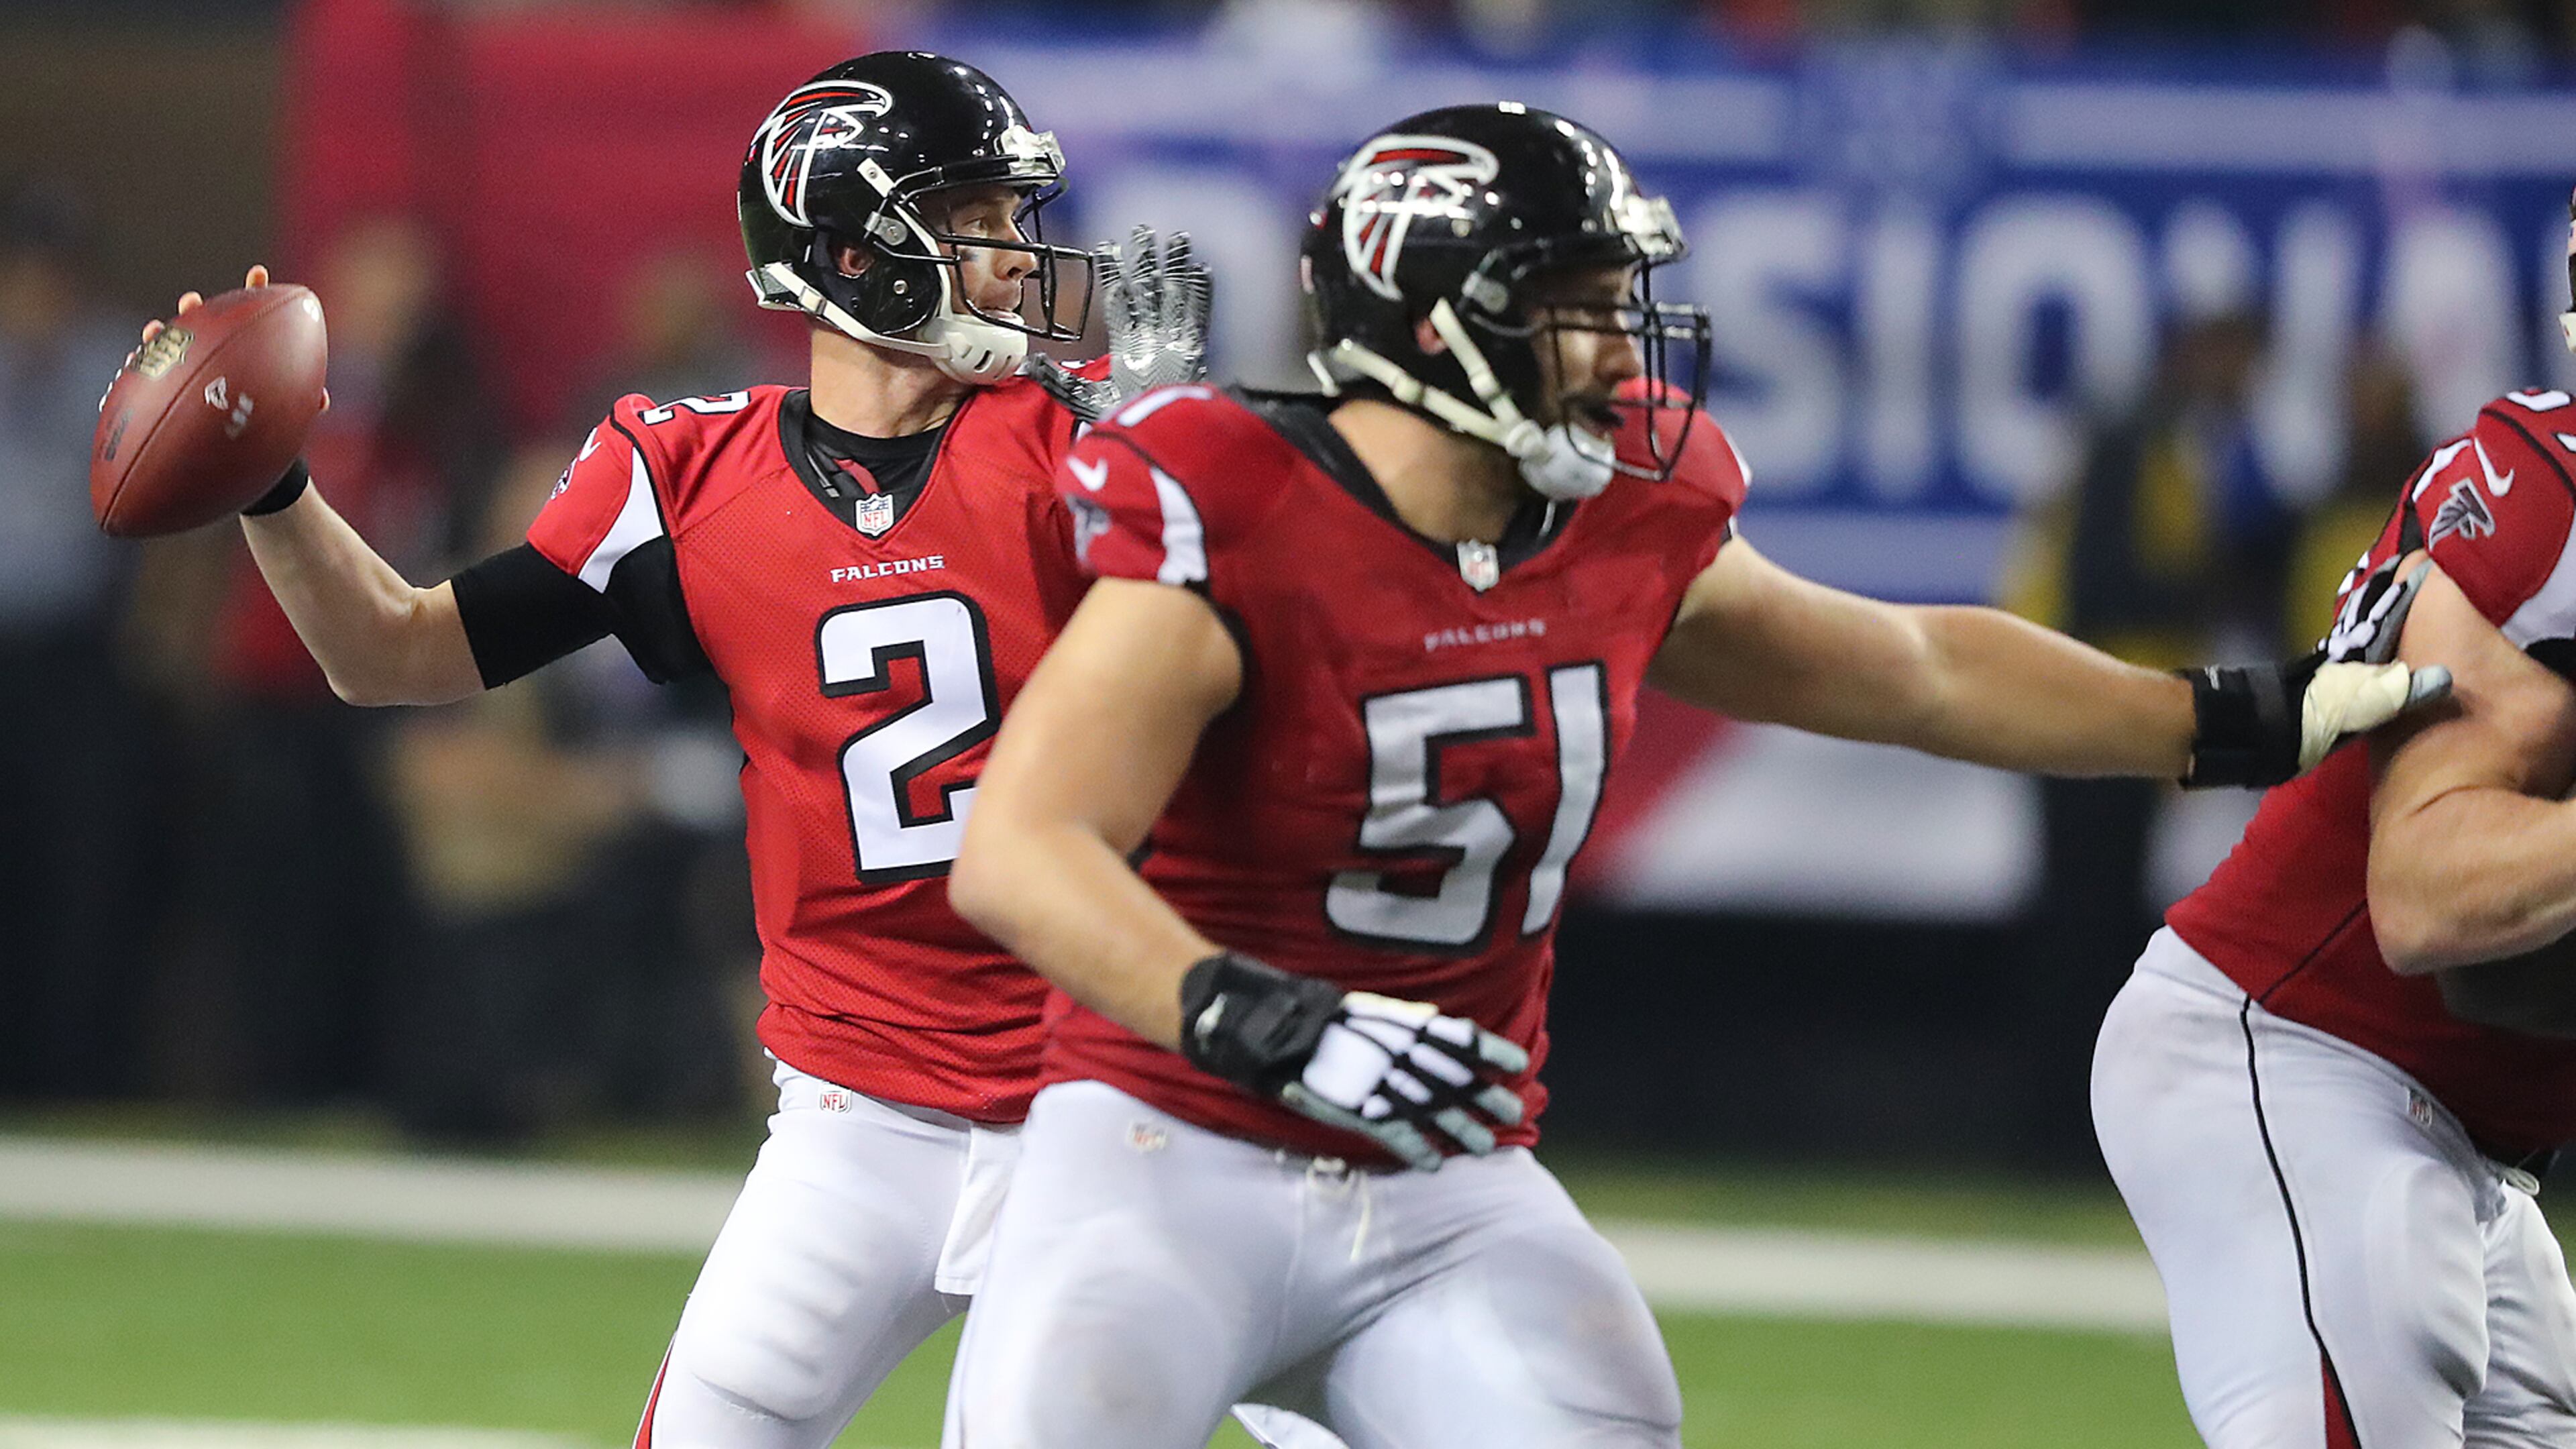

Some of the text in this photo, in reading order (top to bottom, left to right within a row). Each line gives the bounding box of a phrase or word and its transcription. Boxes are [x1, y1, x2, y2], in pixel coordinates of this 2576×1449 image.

[863, 511, 888, 527] NFL
[831, 555, 945, 582] FALCONS
[1424, 618, 1546, 652] FALCONS
[816, 591, 1000, 883] 2
[1326, 660, 1607, 951] 51
[822, 1093, 847, 1111] NFL
